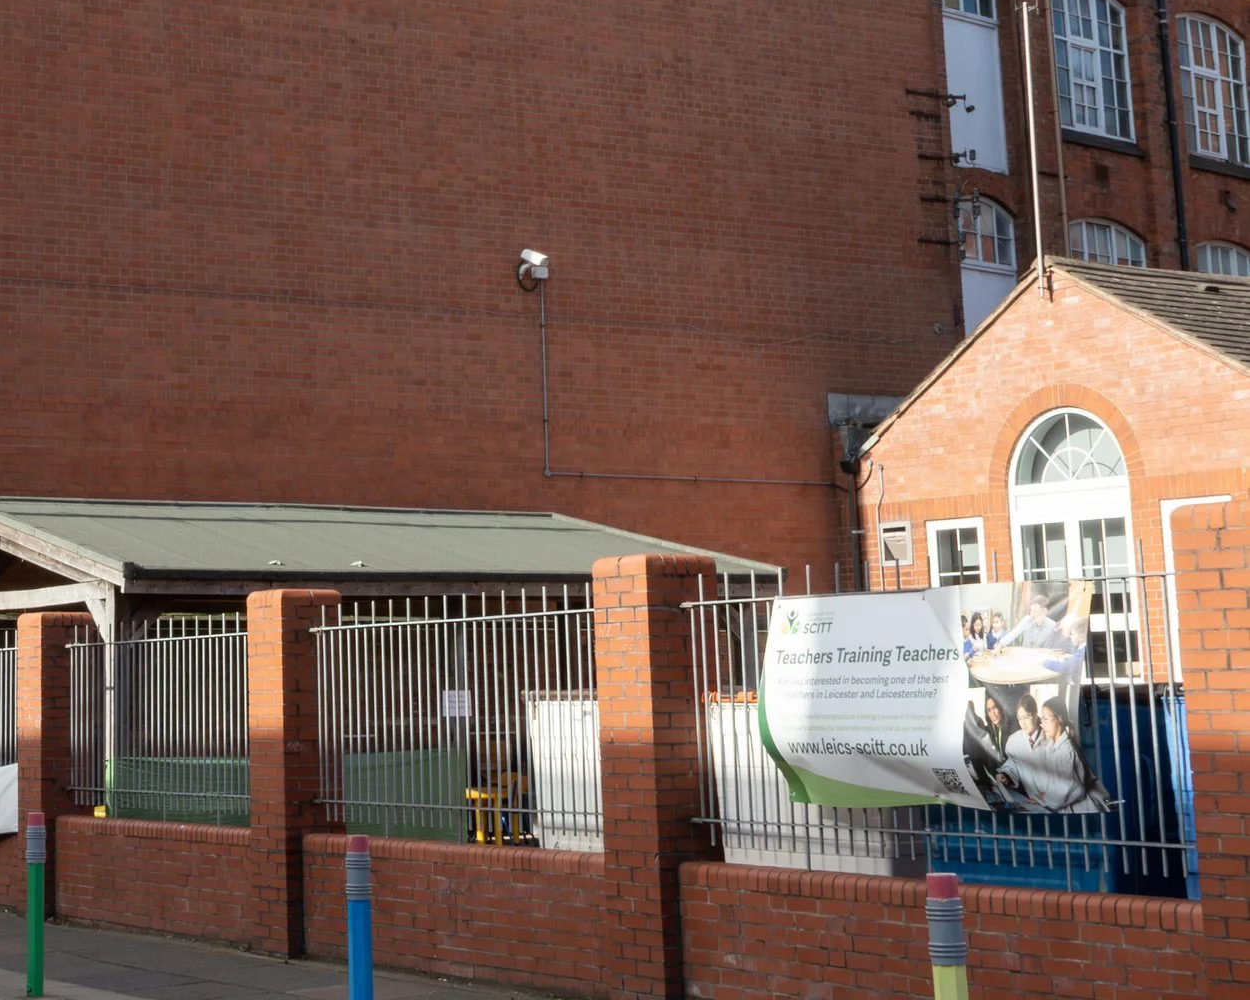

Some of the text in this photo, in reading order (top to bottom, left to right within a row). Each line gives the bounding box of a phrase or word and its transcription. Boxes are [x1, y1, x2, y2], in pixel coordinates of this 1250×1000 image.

[803, 621, 834, 634] SCITT
[776, 643, 960, 667] Teachers Training Teachers
[805, 675, 841, 686] interested
[842, 675, 850, 685] in
[851, 674, 890, 687] becoming
[890, 676, 907, 685] one
[907, 674, 918, 685] of
[917, 673, 932, 684] the
[931, 673, 949, 684] best
[815, 689, 823, 699] in
[824, 689, 858, 699] Leicester
[859, 689, 875, 699] and
[876, 688, 938, 699] Leicestershire?
[787, 737, 929, 757] www.leics-scitt.co.uk
